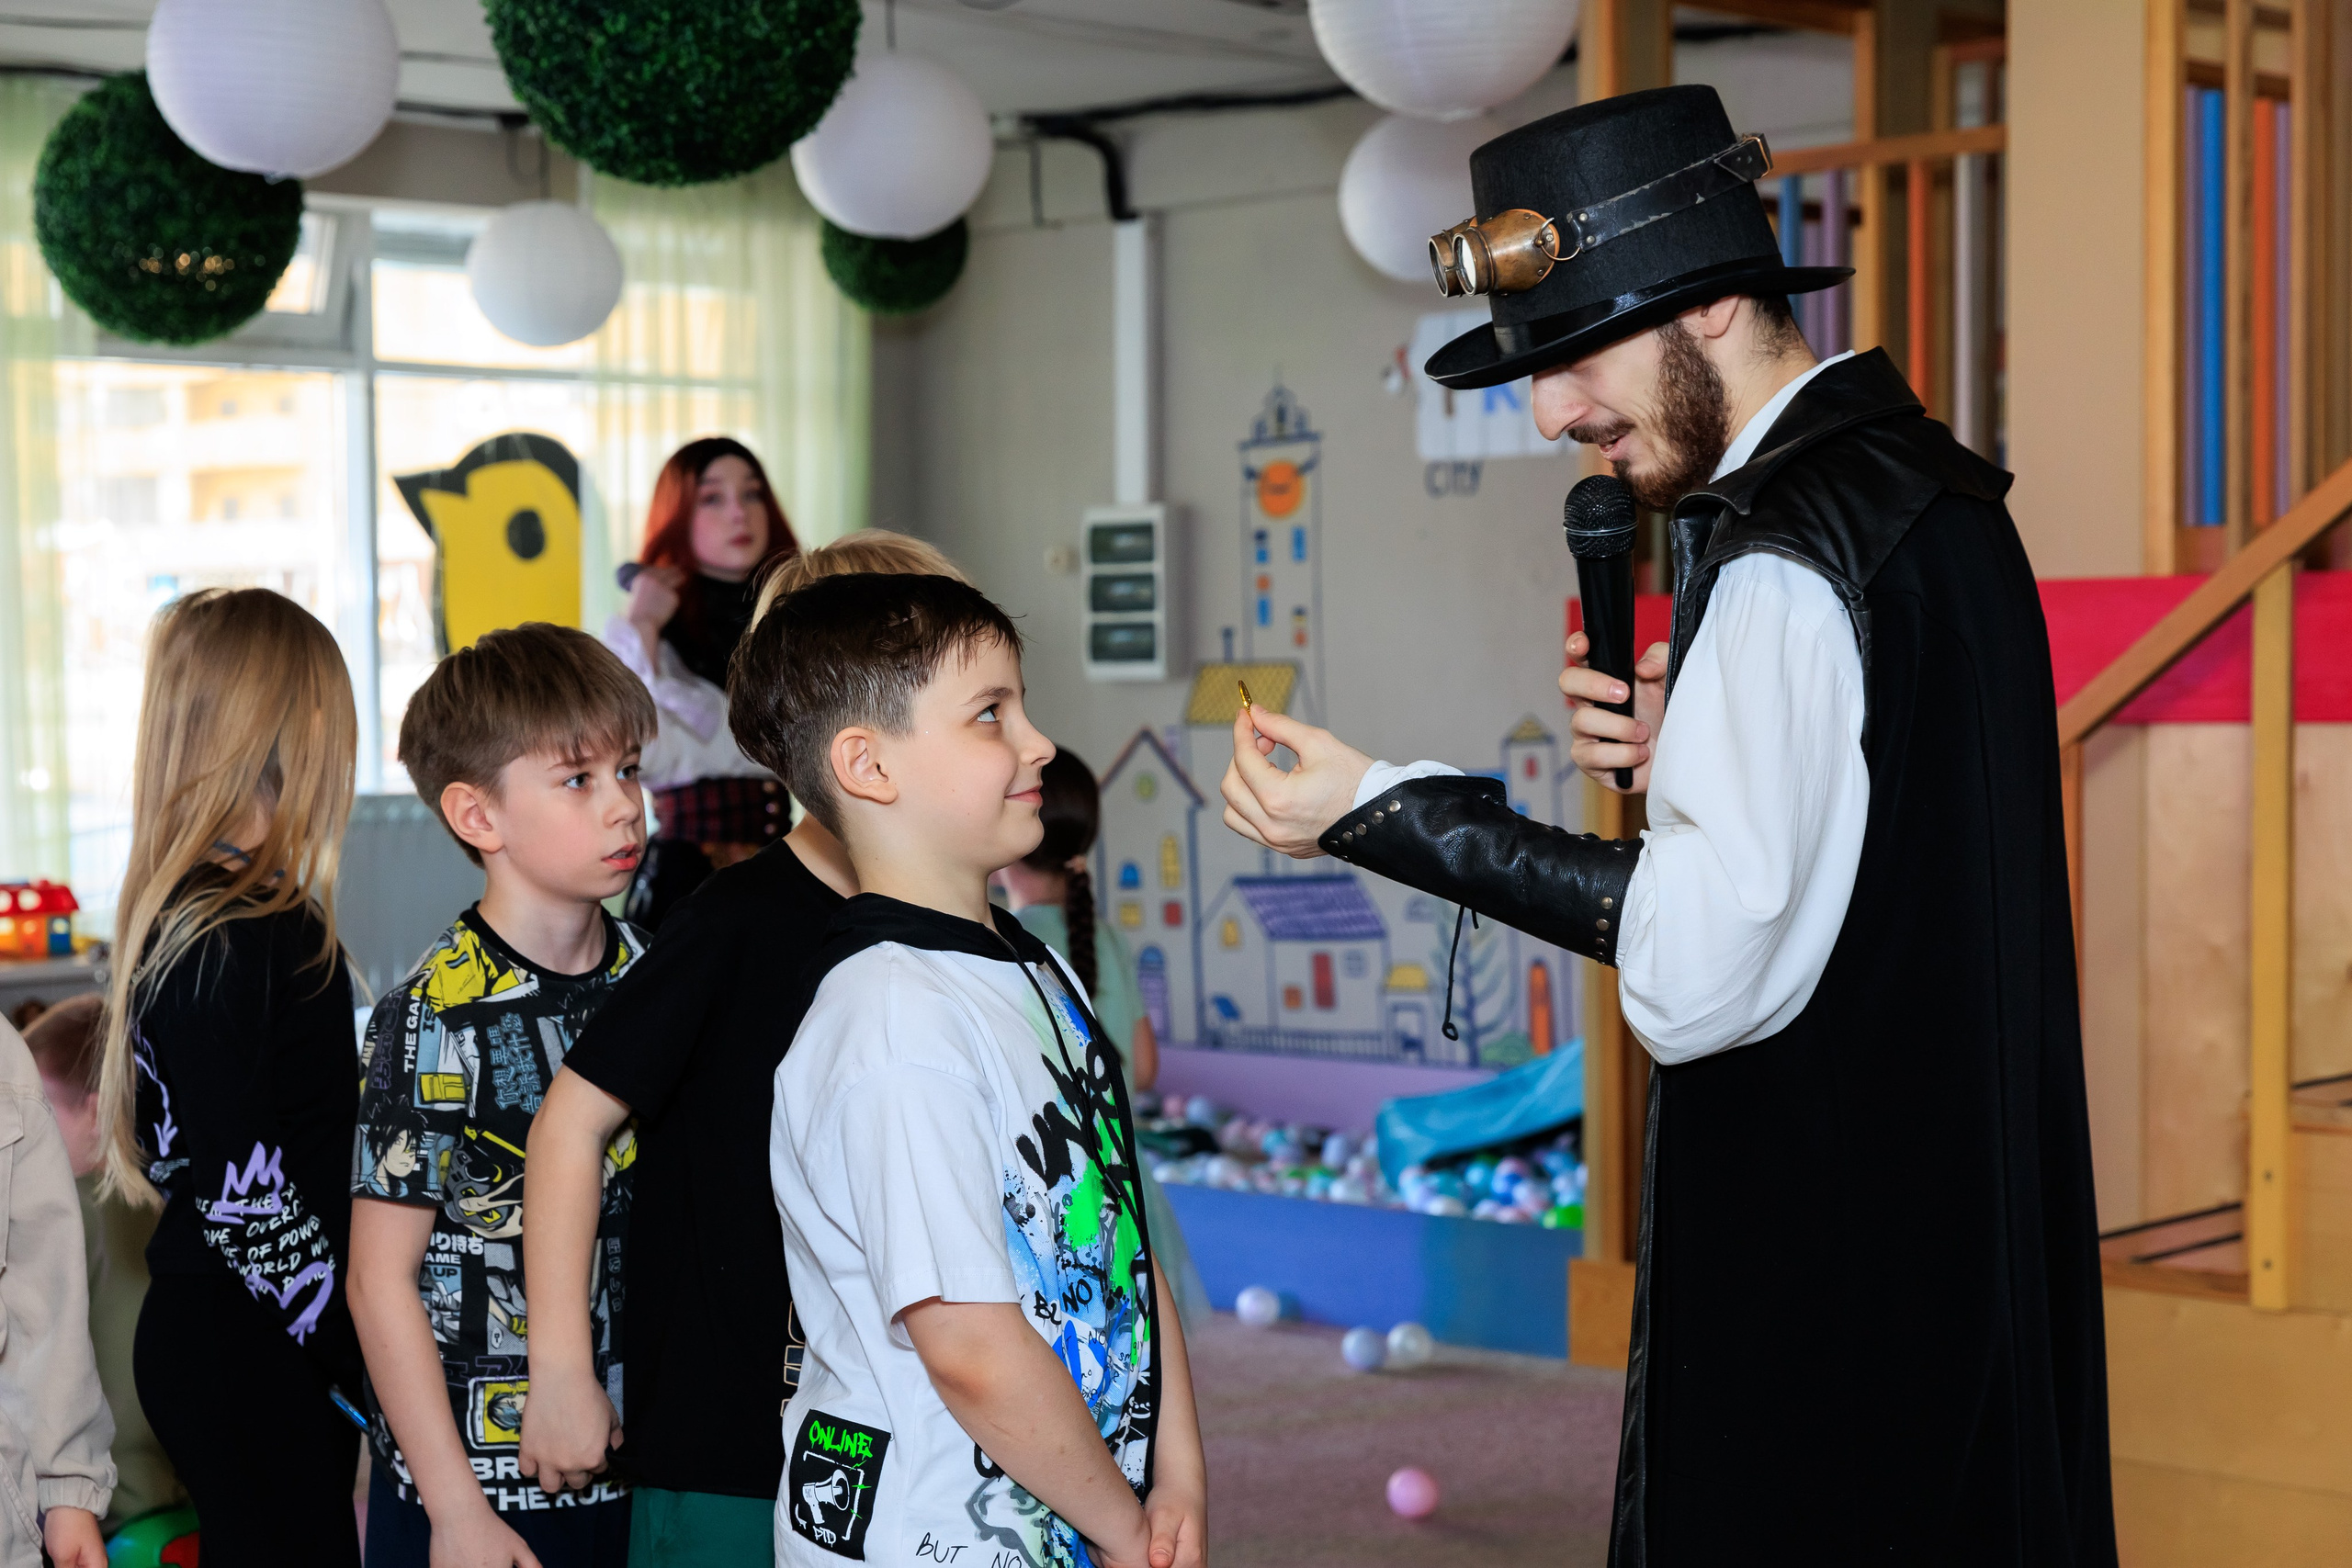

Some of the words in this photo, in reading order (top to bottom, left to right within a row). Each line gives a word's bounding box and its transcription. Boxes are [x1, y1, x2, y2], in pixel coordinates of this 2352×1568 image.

[403, 1032, 418, 1073] THE
[238, 1251, 301, 1276] WORLD
[247, 1242, 273, 1261] OF
[424, 1252, 461, 1265] AME
[433, 1267, 458, 1279] UP
[1061, 1278, 1093, 1314] NO
[808, 1420, 873, 1459] ONLINE
[469, 1456, 520, 1481] BR
[555, 1483, 629, 1508] RUL
[916, 1532, 968, 1563] BUT
